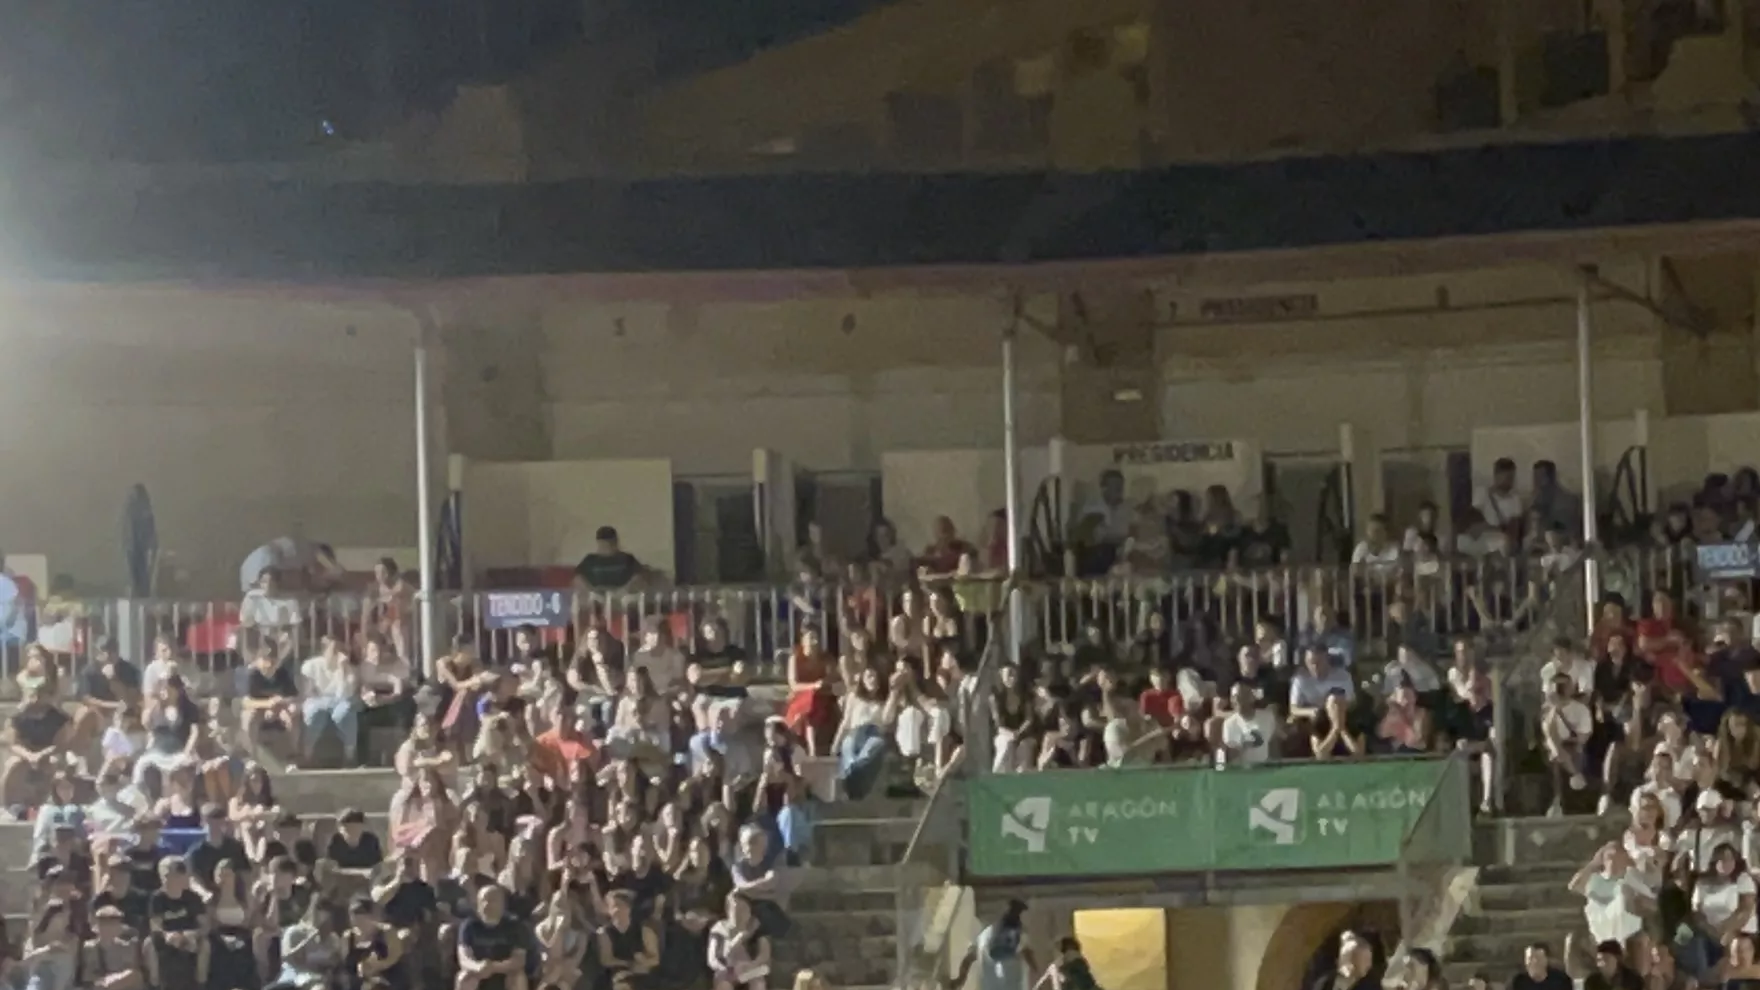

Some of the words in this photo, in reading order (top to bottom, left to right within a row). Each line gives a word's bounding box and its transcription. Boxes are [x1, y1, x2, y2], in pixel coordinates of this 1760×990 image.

[1112, 441, 1234, 464] PRESIDENCIA
[487, 592, 543, 617] TENDIDO
[1066, 826, 1100, 845] TV
[1316, 817, 1349, 837] TV
